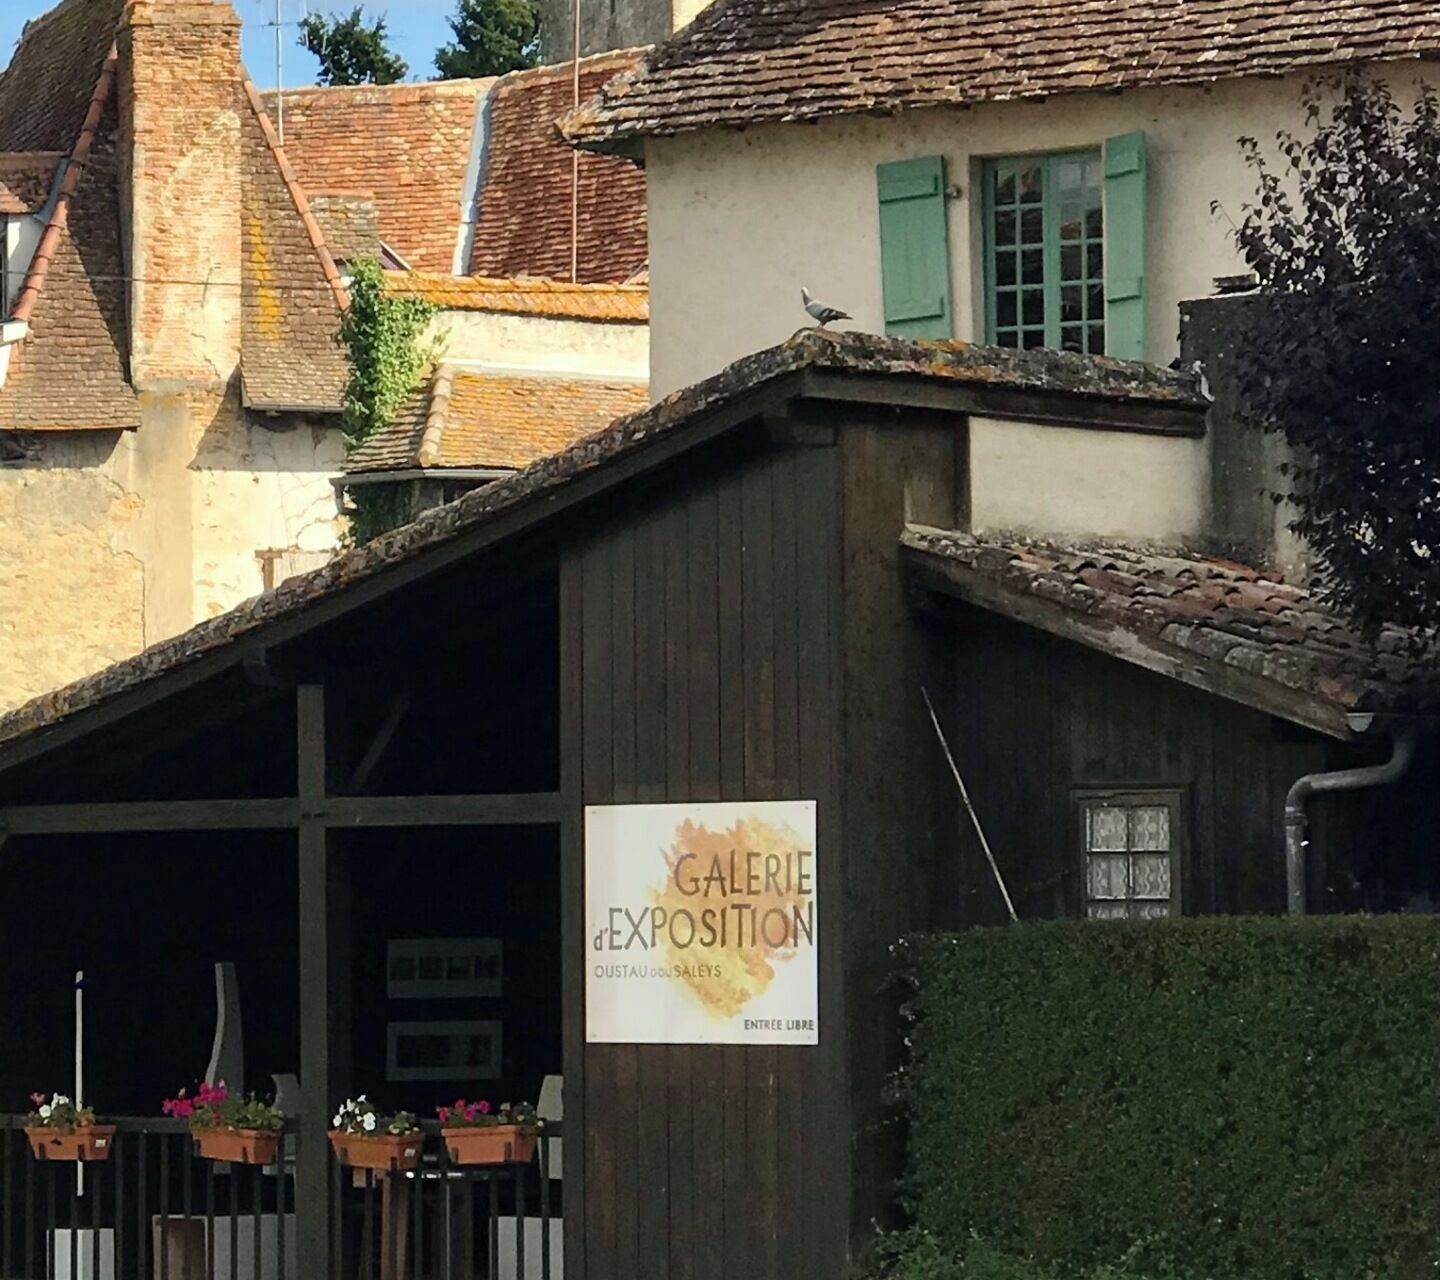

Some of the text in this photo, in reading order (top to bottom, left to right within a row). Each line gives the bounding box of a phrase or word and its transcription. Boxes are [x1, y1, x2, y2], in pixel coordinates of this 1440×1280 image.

[675, 850, 813, 897] GALERIE
[593, 902, 813, 951] d'EXPOSITION
[594, 965, 648, 978] OUSTAU
[673, 964, 722, 978] SALEYS
[744, 1018, 815, 1030] ENTRÉE LIBRE
